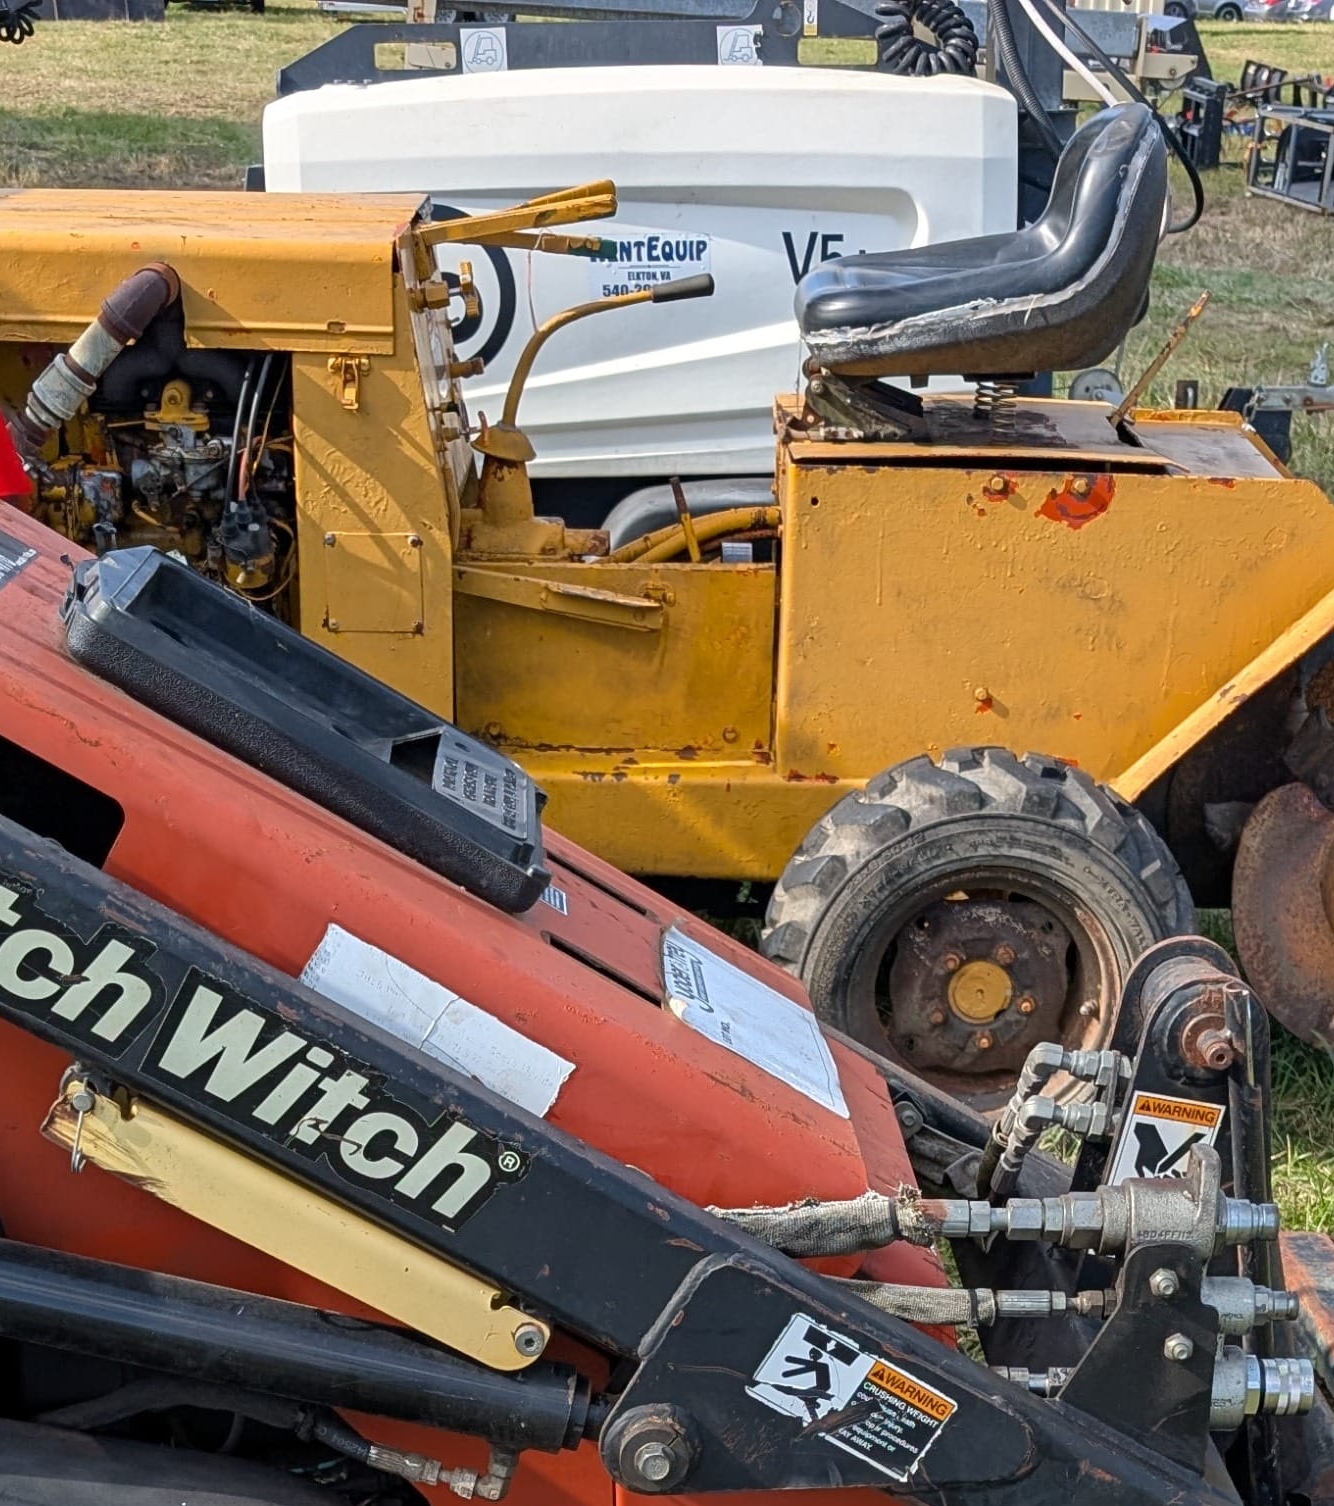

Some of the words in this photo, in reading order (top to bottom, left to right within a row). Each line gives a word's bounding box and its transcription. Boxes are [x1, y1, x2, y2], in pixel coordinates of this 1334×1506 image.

[589, 236, 708, 263] NTEQUIP
[660, 271, 672, 281] VA
[1152, 1101, 1216, 1123] WARNING
[863, 1381, 907, 1410] CRUSHING
[886, 1373, 948, 1416] WARNING
[880, 1429, 919, 1454] procedures
